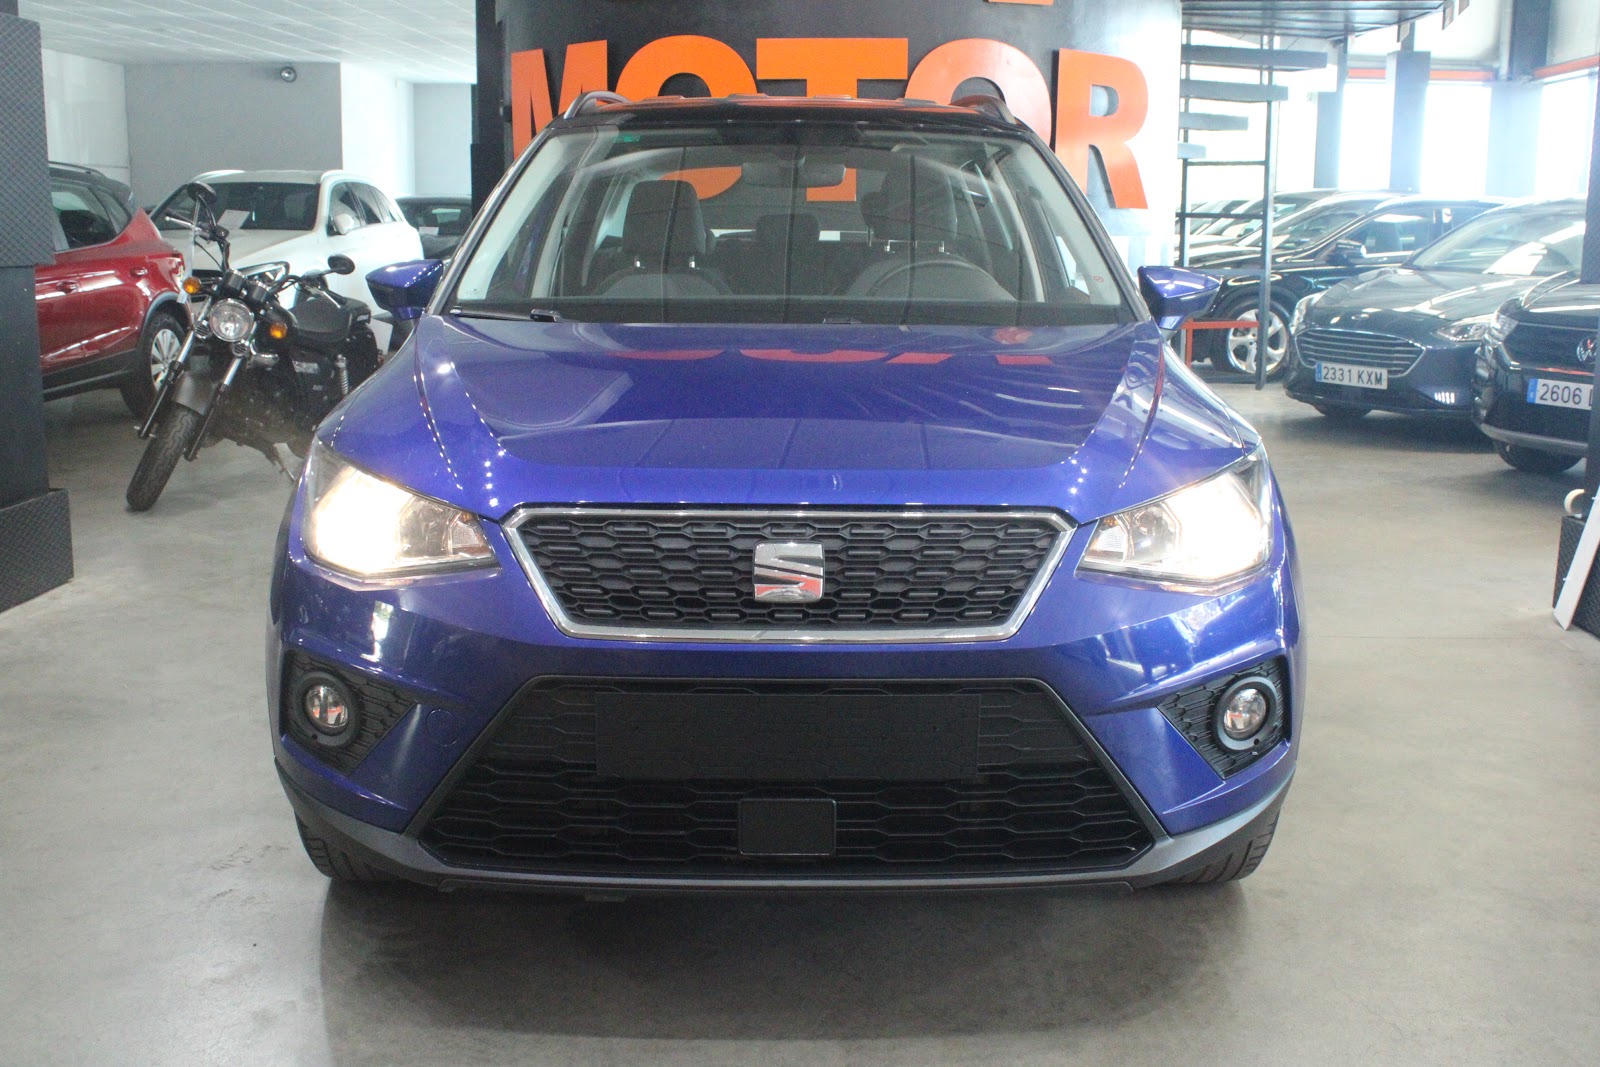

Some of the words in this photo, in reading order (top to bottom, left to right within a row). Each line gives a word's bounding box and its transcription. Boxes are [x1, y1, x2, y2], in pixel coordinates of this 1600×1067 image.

[1323, 366, 1352, 383] 2331
[1357, 369, 1383, 386] KXM
[1540, 383, 1582, 405] 2606
